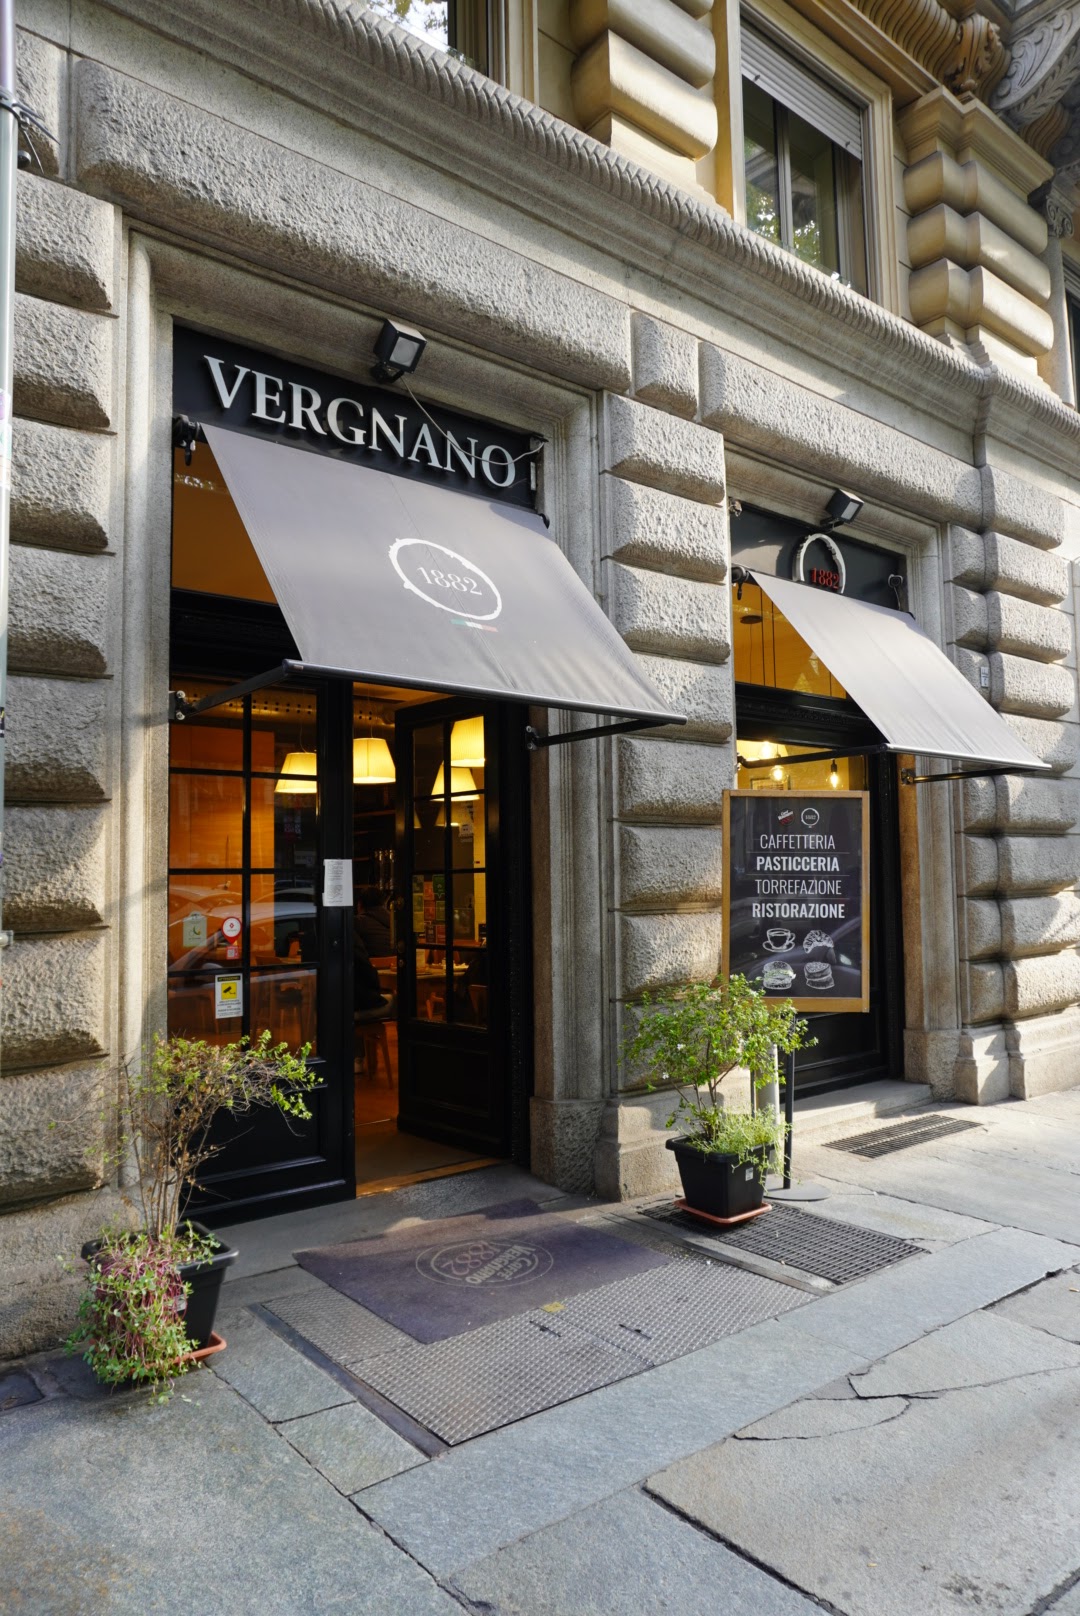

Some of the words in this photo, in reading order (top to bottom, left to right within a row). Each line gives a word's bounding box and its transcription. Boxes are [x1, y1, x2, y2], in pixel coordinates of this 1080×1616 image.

[204, 355, 516, 488] VERGNANO
[417, 567, 483, 596] 1882
[812, 568, 840, 589] 1882
[760, 834, 835, 849] CAFFETTERIA
[756, 856, 840, 872] PASTICCERIA
[755, 879, 842, 895] TORREFAZIONE
[752, 903, 845, 919] RISTORAZIONE
[441, 1240, 501, 1276] 1882
